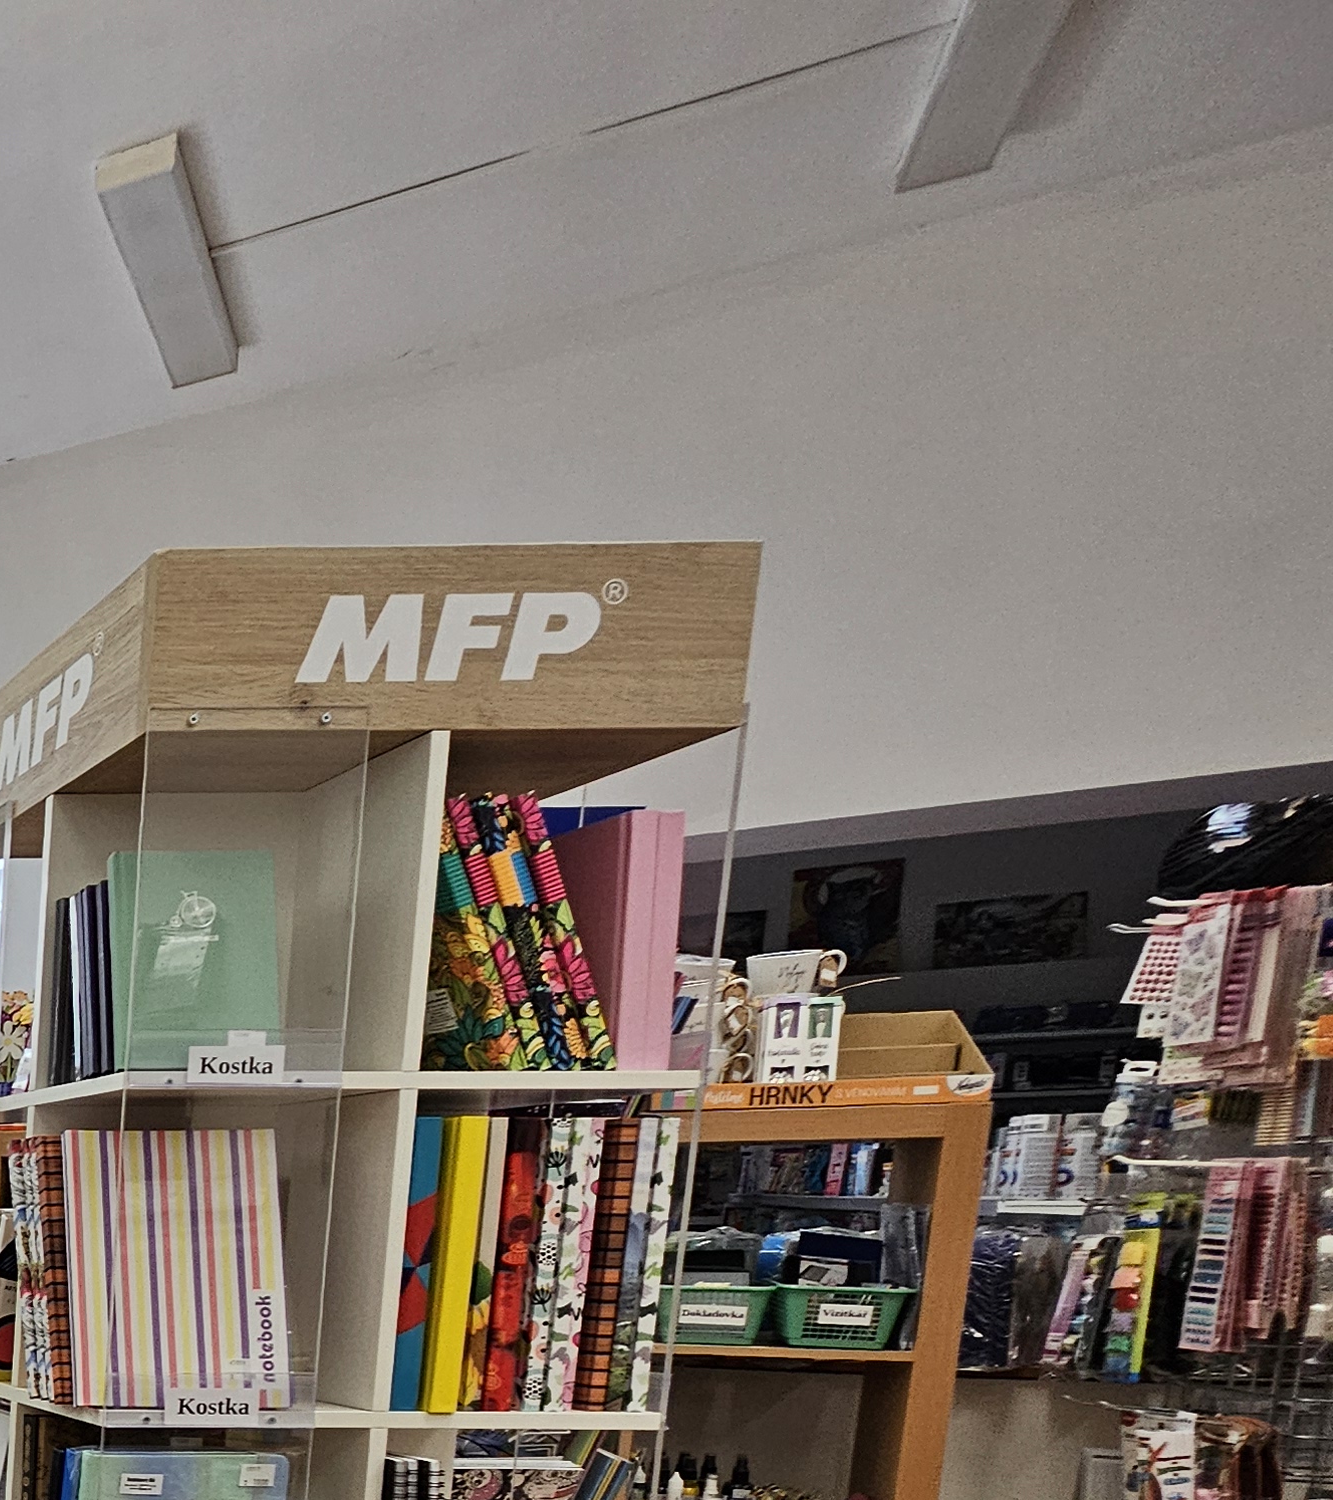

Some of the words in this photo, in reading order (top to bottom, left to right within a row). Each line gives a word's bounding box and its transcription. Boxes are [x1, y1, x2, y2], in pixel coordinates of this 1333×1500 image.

[295, 591, 601, 683] MFP
[199, 1055, 273, 1076] Kostka
[748, 1085, 833, 1106] HRNKY
[255, 1295, 276, 1384] notebook
[177, 1397, 250, 1415] Kostka
